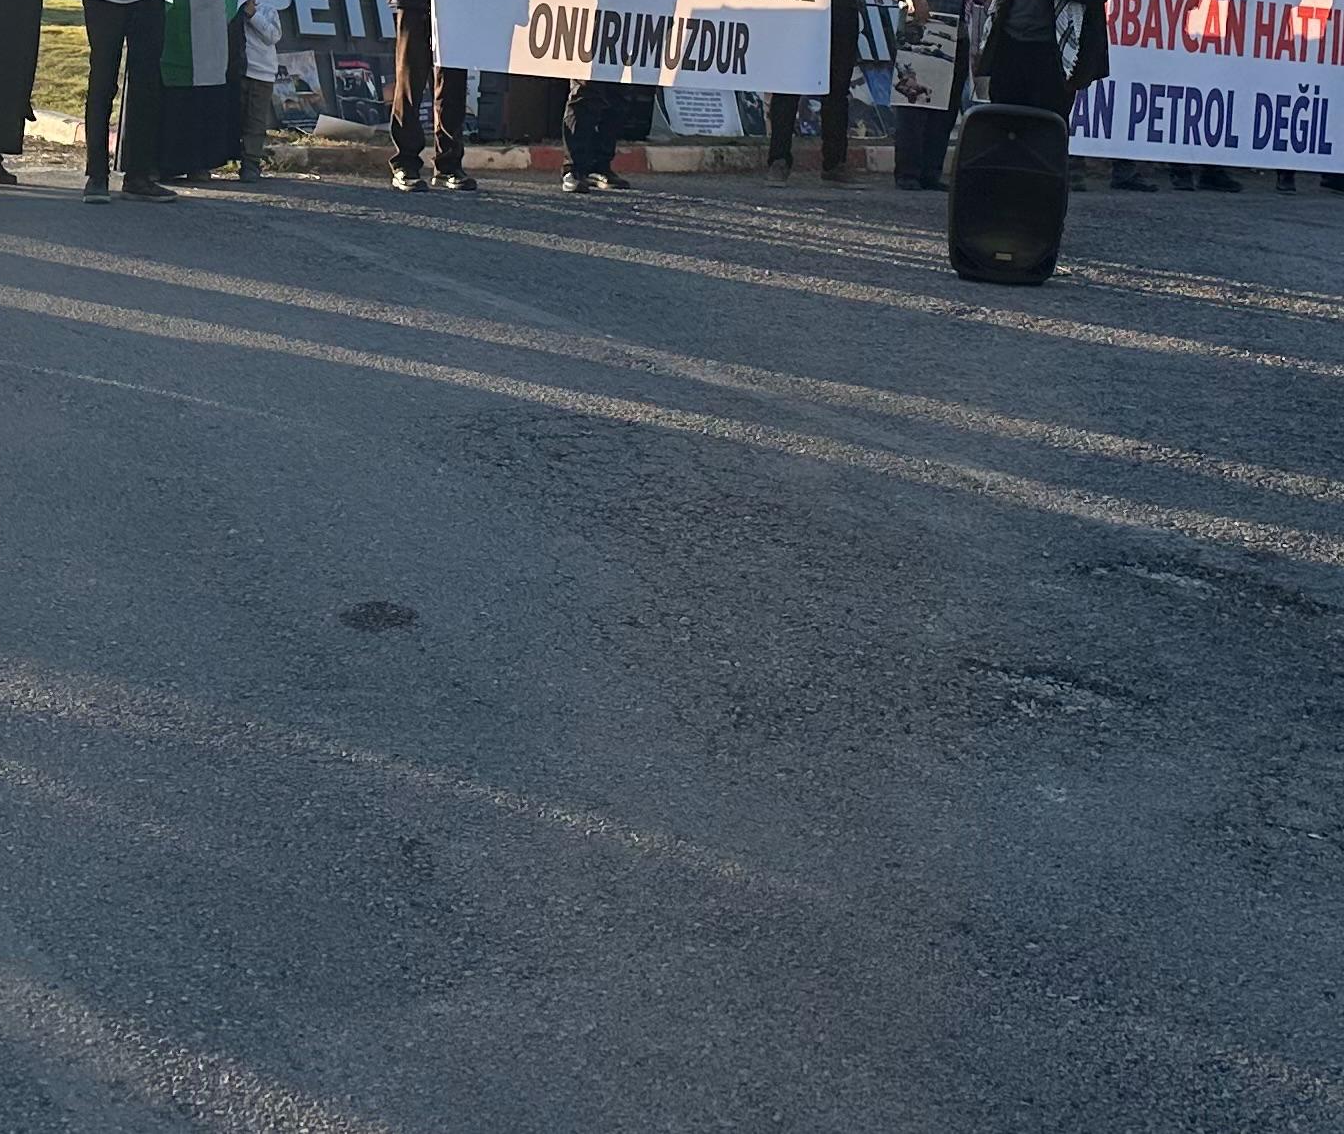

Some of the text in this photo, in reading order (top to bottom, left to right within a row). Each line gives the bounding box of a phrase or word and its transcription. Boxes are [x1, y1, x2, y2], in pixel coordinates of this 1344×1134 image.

[528, 2, 750, 75] ONURUMUZDUR
[1127, 81, 1239, 149] PETROL
[1252, 82, 1333, 155] DEĞİL
